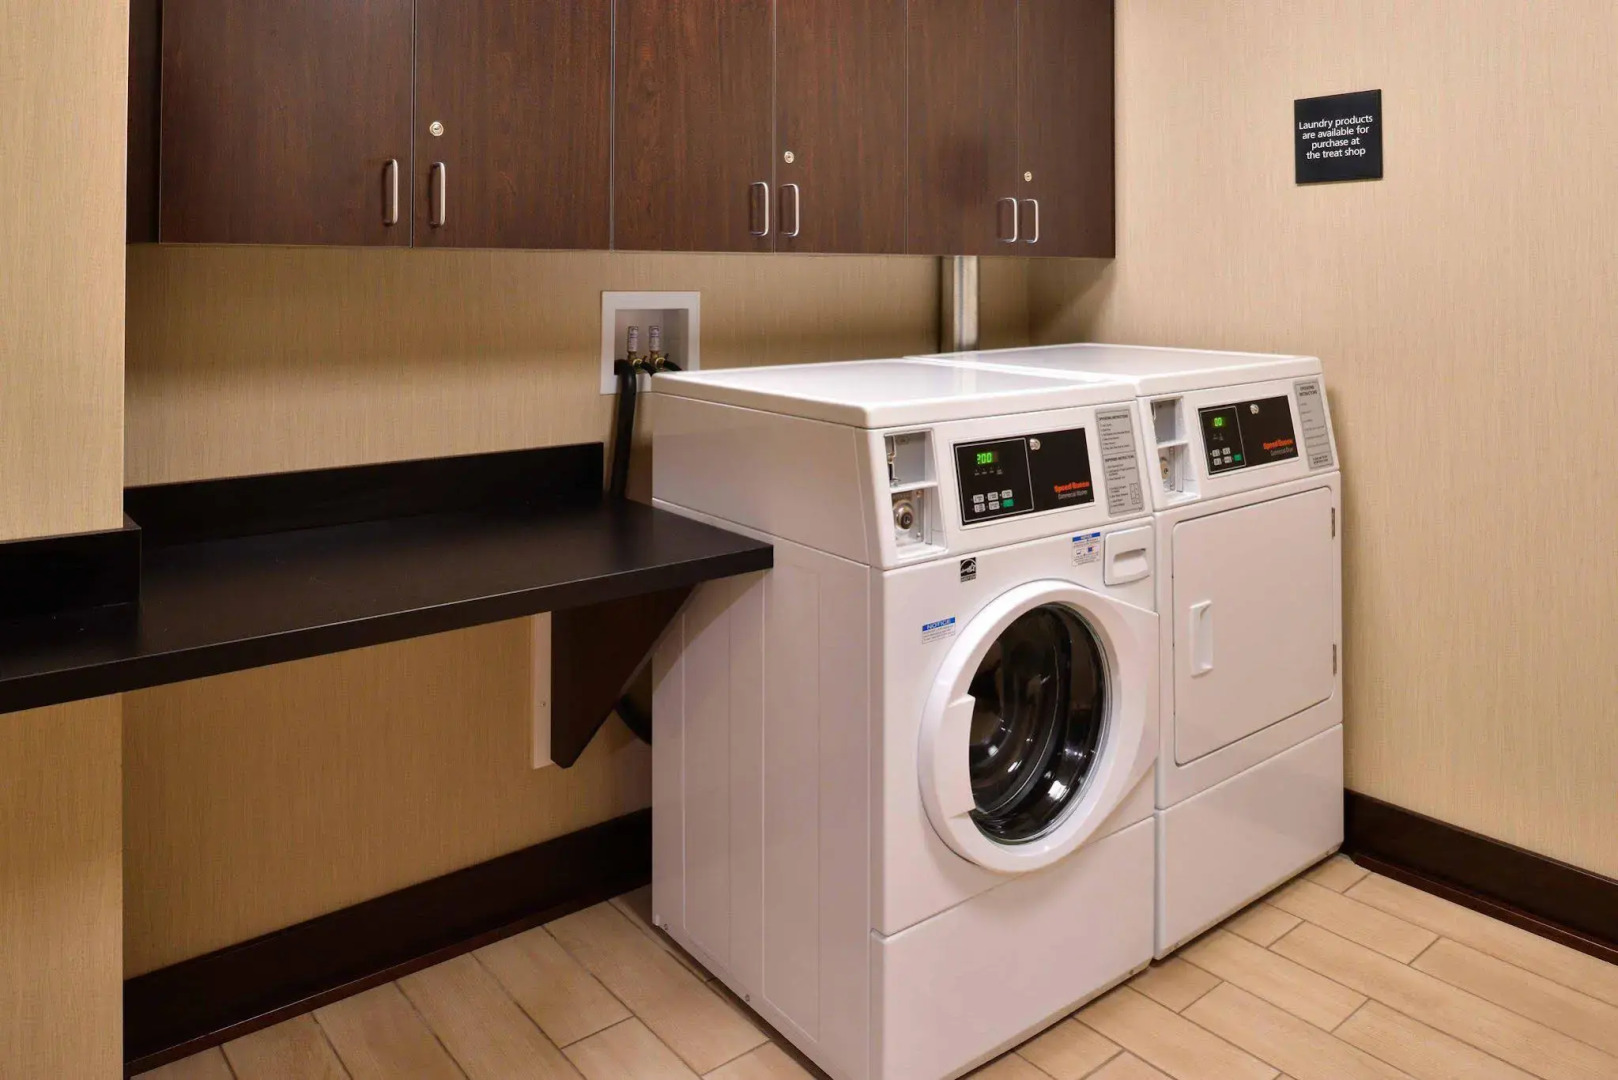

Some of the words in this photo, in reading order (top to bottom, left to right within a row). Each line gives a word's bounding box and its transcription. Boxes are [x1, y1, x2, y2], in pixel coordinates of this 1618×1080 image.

[1298, 118, 1333, 130] Laundry
[1334, 115, 1373, 128] products
[1302, 132, 1316, 140] are
[1317, 126, 1354, 138] available
[1356, 125, 1370, 134] for
[1311, 138, 1349, 150] purchase
[1350, 137, 1361, 146] at
[1306, 151, 1321, 160] the
[1322, 149, 1343, 158] treat
[1344, 147, 1366, 157] shop
[926, 618, 950, 631] NOTICE
